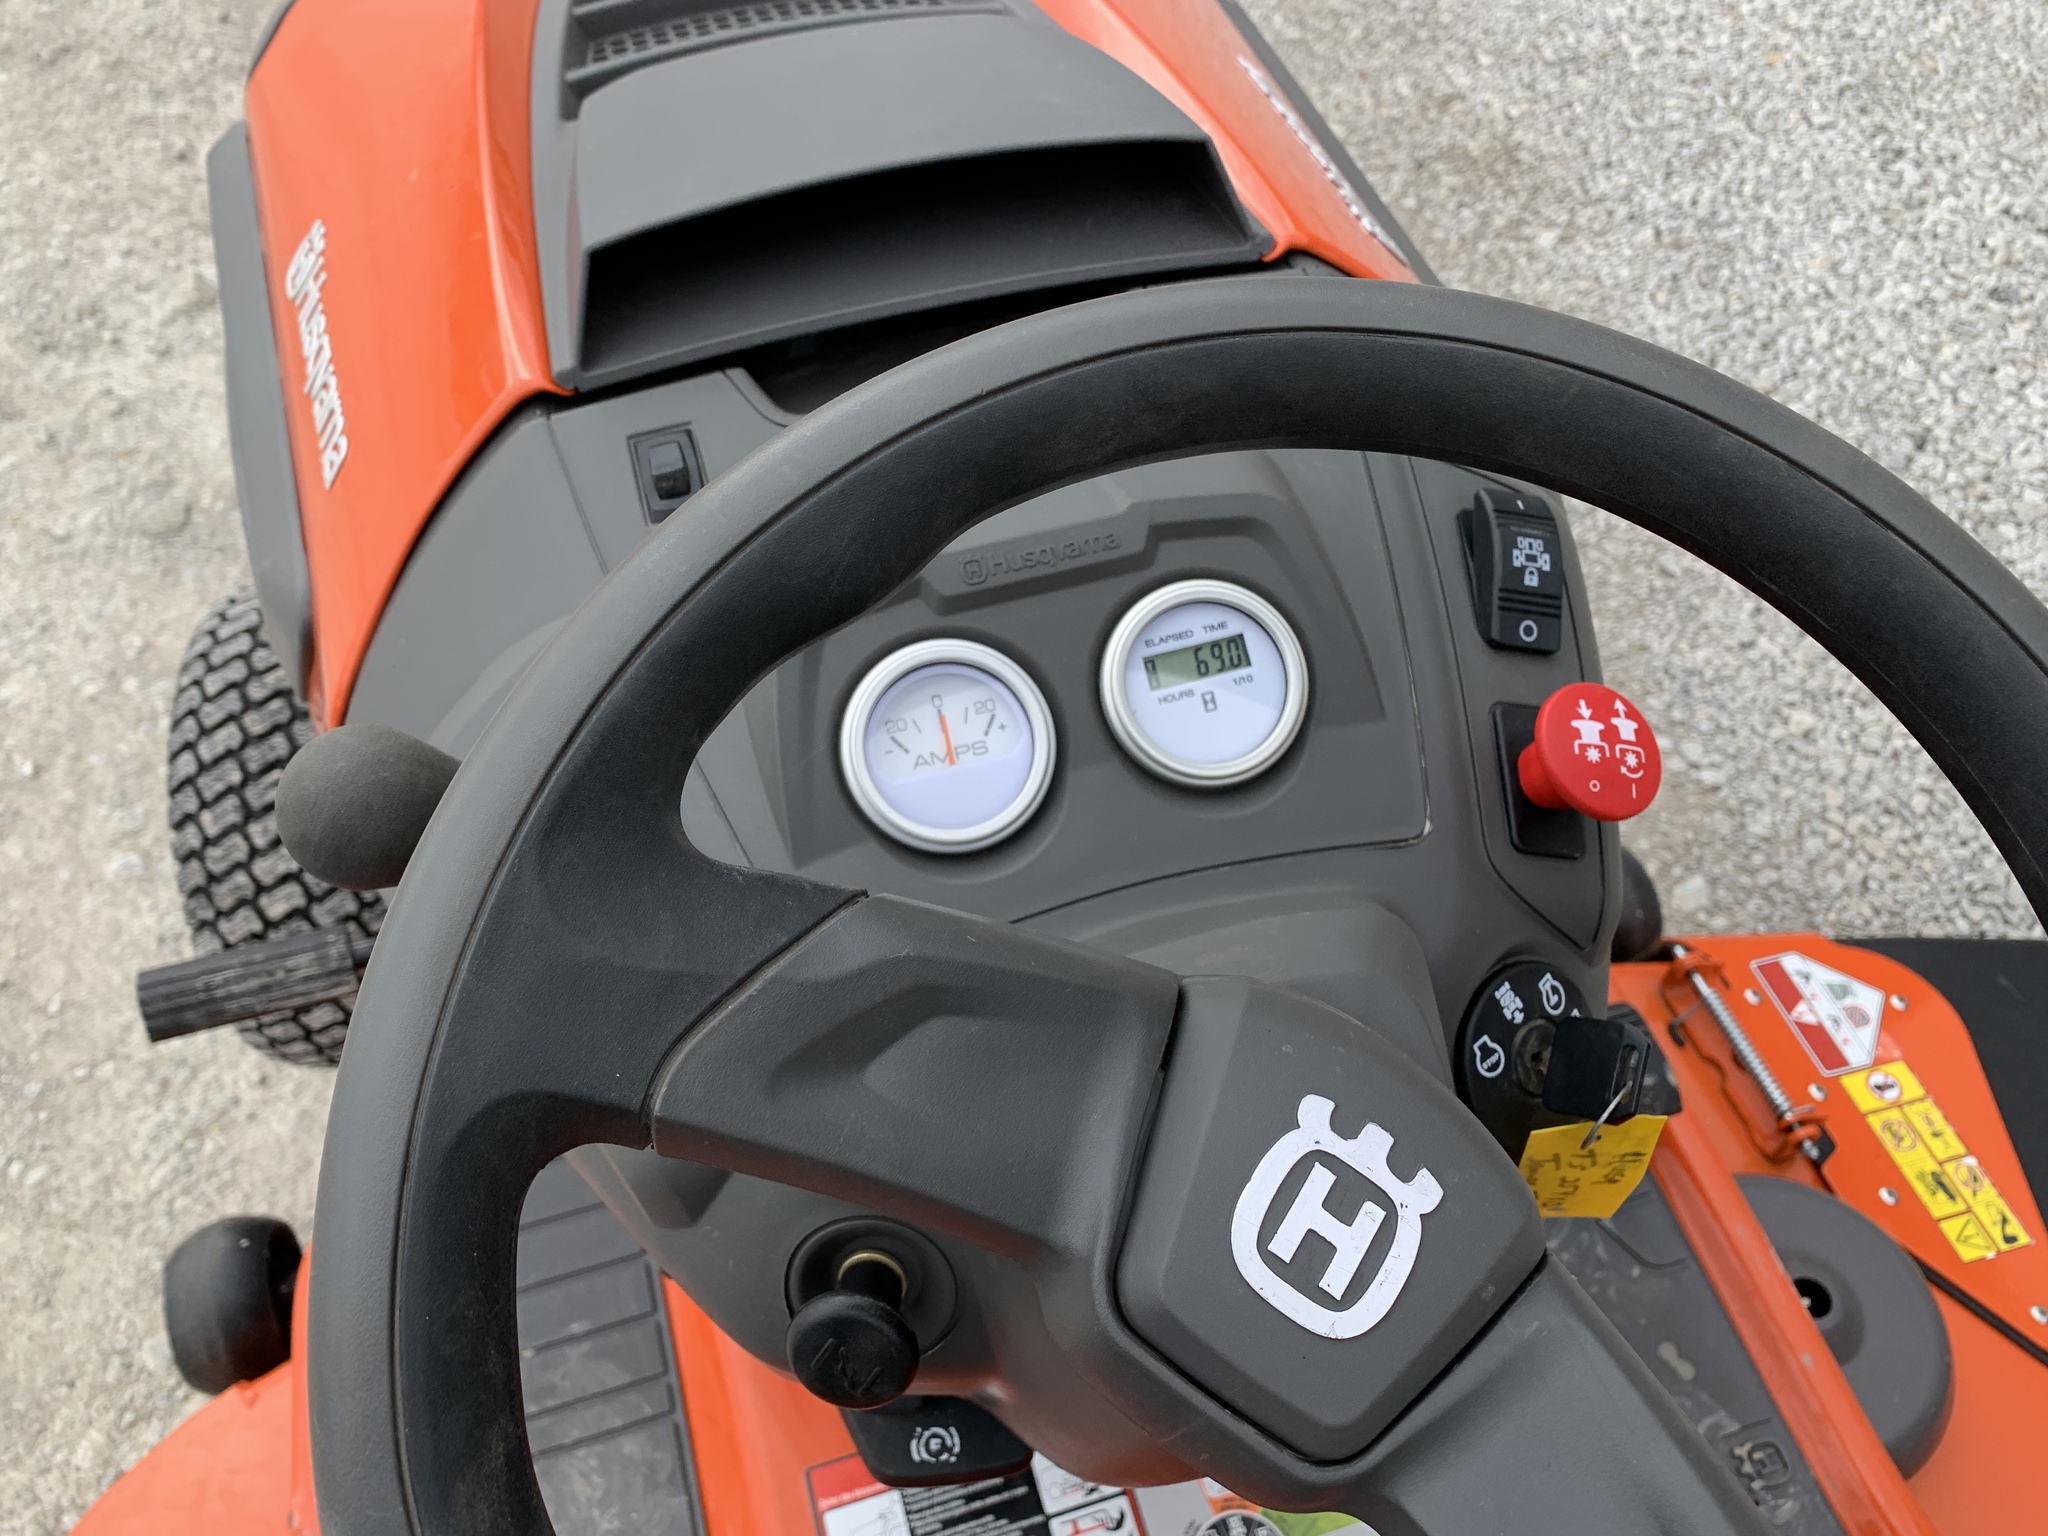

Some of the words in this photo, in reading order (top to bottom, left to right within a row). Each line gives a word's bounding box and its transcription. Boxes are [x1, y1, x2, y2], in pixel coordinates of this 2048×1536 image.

[295, 254, 348, 490] Husqvarna
[991, 533, 1122, 577] Husqvarna
[1144, 629, 1195, 649] ELAPSED
[1202, 621, 1229, 635] TIME
[1232, 674, 1254, 687] 1/10
[931, 694, 944, 710] 0
[1157, 689, 1195, 706] HOURS
[974, 699, 997, 716] 20
[885, 717, 908, 736] 20
[913, 740, 989, 771] AMPS
